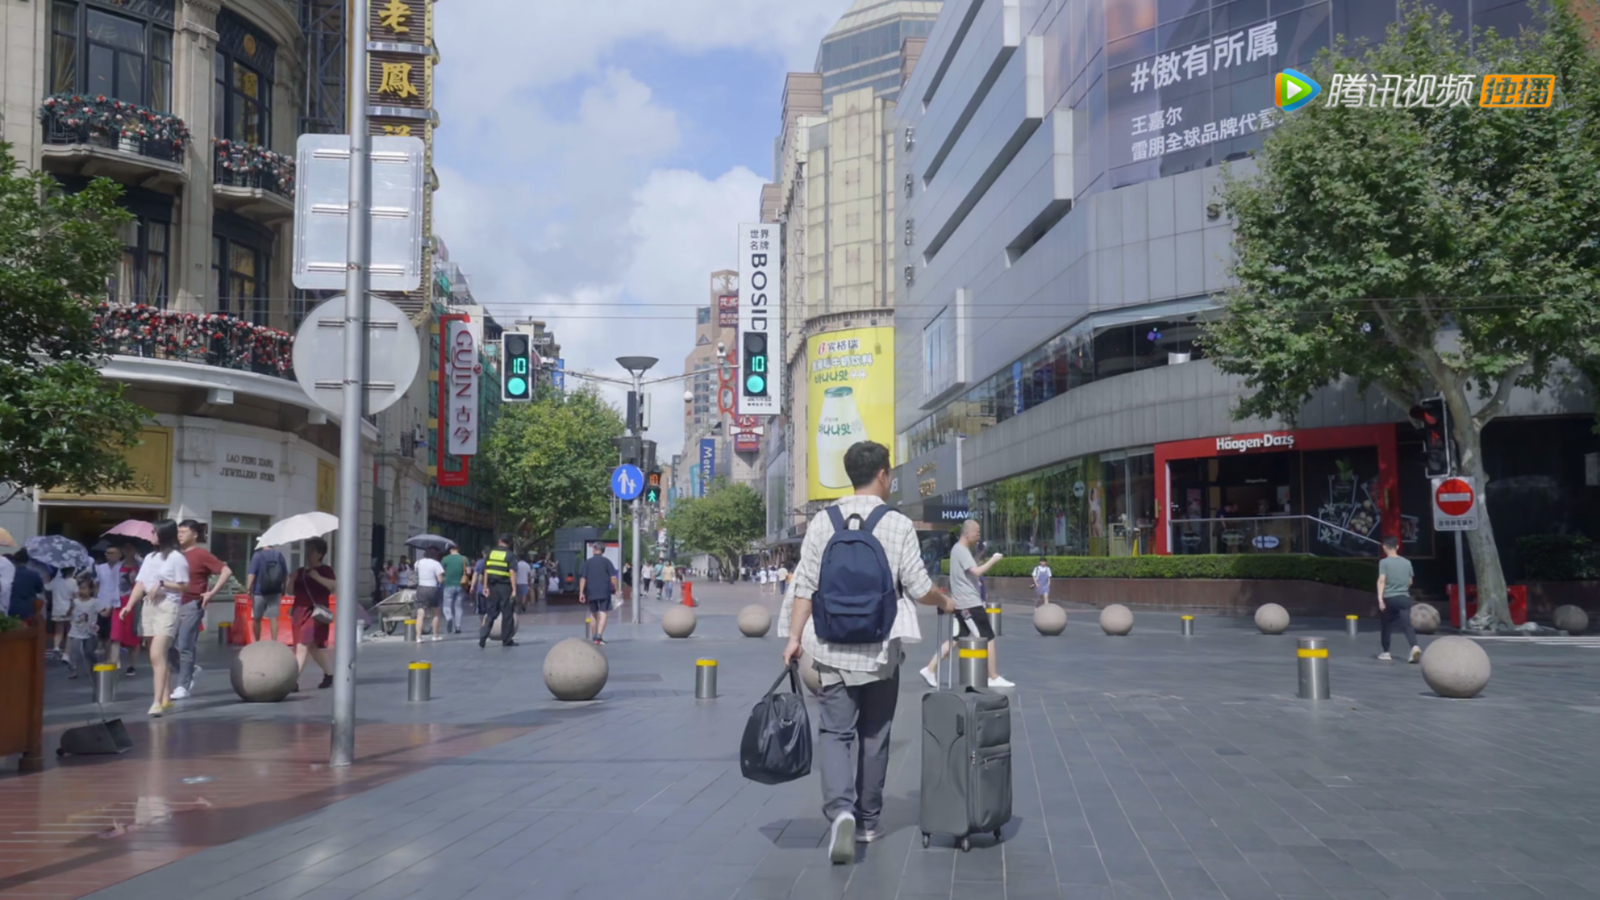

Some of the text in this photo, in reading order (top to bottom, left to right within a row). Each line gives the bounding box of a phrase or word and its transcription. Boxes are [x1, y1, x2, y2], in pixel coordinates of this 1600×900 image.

[1130, 21, 1279, 93] #傲有所属
[1131, 107, 1183, 136] 王嘉尔
[750, 229, 769, 239] 世界
[750, 241, 769, 251] 名牌
[513, 357, 526, 374] 10
[751, 355, 765, 373] 10
[452, 330, 474, 445] GUJIN 古今
[226, 453, 240, 463] LAO
[219, 467, 257, 479] JEWELLERS
